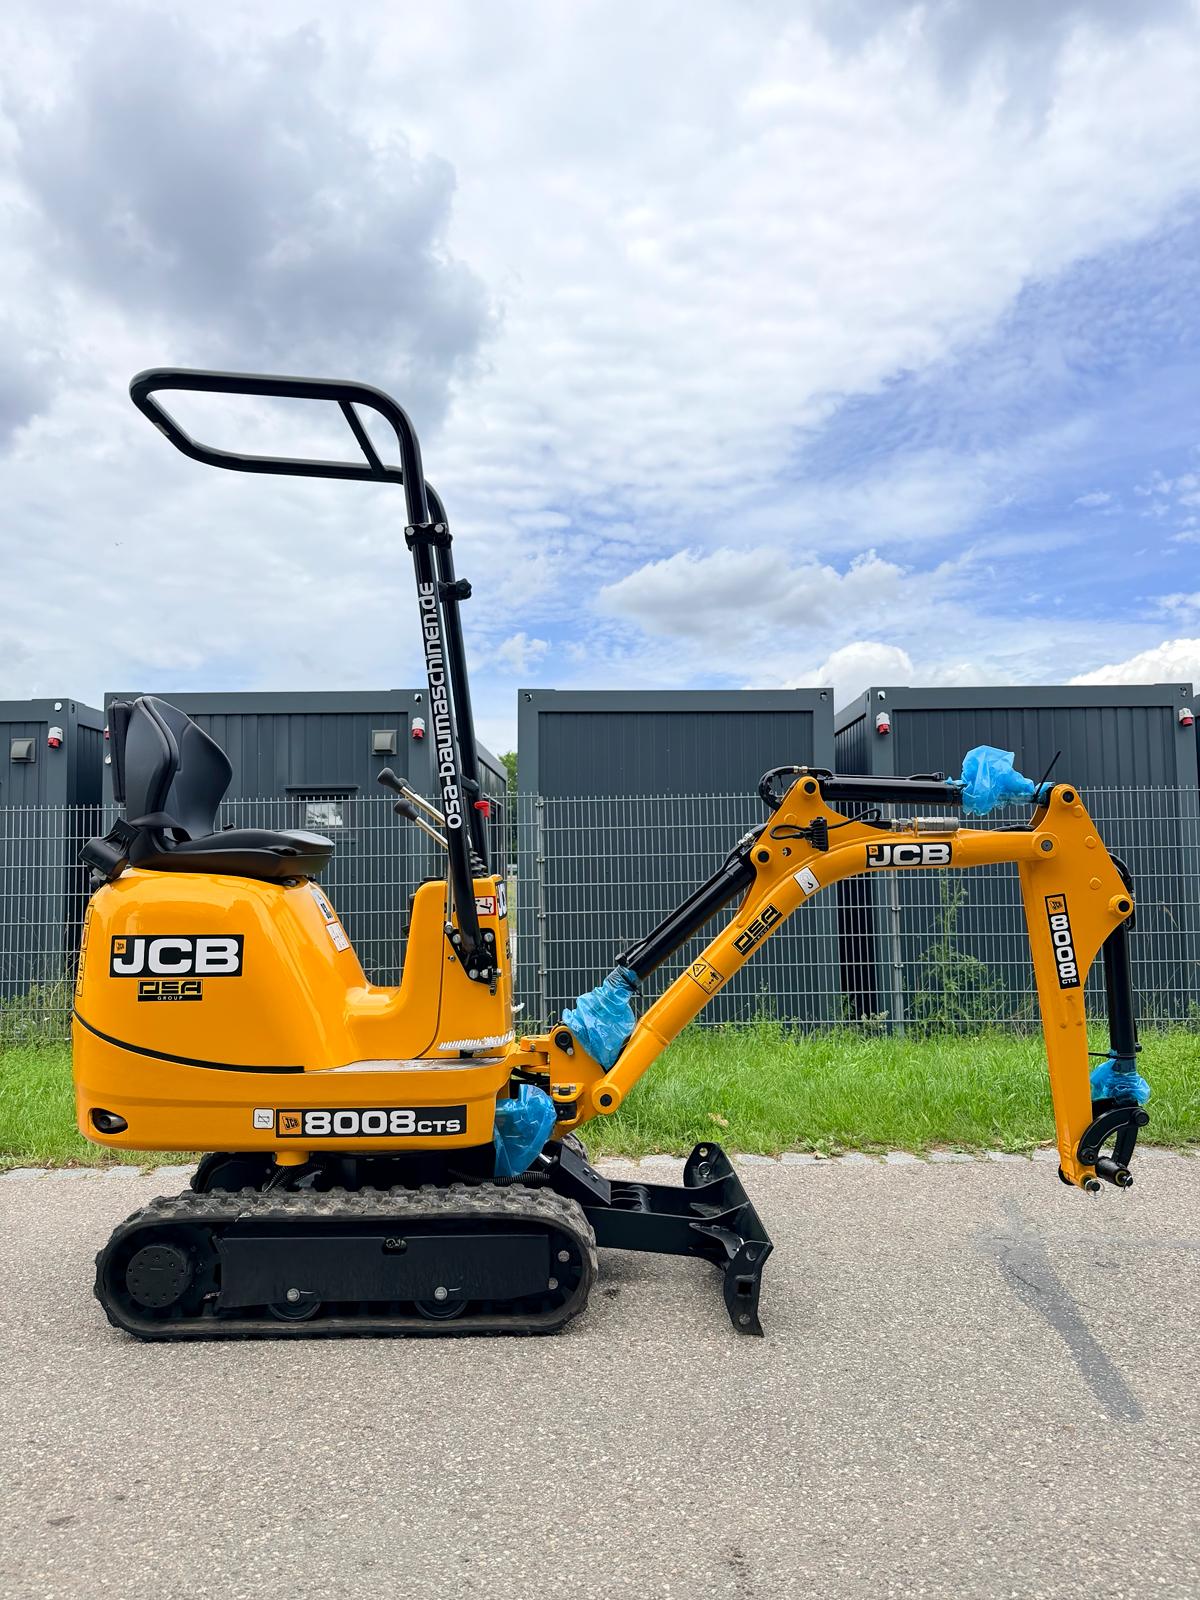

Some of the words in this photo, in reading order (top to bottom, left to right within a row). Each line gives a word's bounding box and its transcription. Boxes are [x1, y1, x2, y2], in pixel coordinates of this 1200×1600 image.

[420, 582, 462, 829] osa-baumaschinen.de
[869, 844, 950, 866] JCB
[113, 938, 240, 974] JCB
[1050, 914, 1077, 978] 8008
[282, 1115, 300, 1131] JCB
